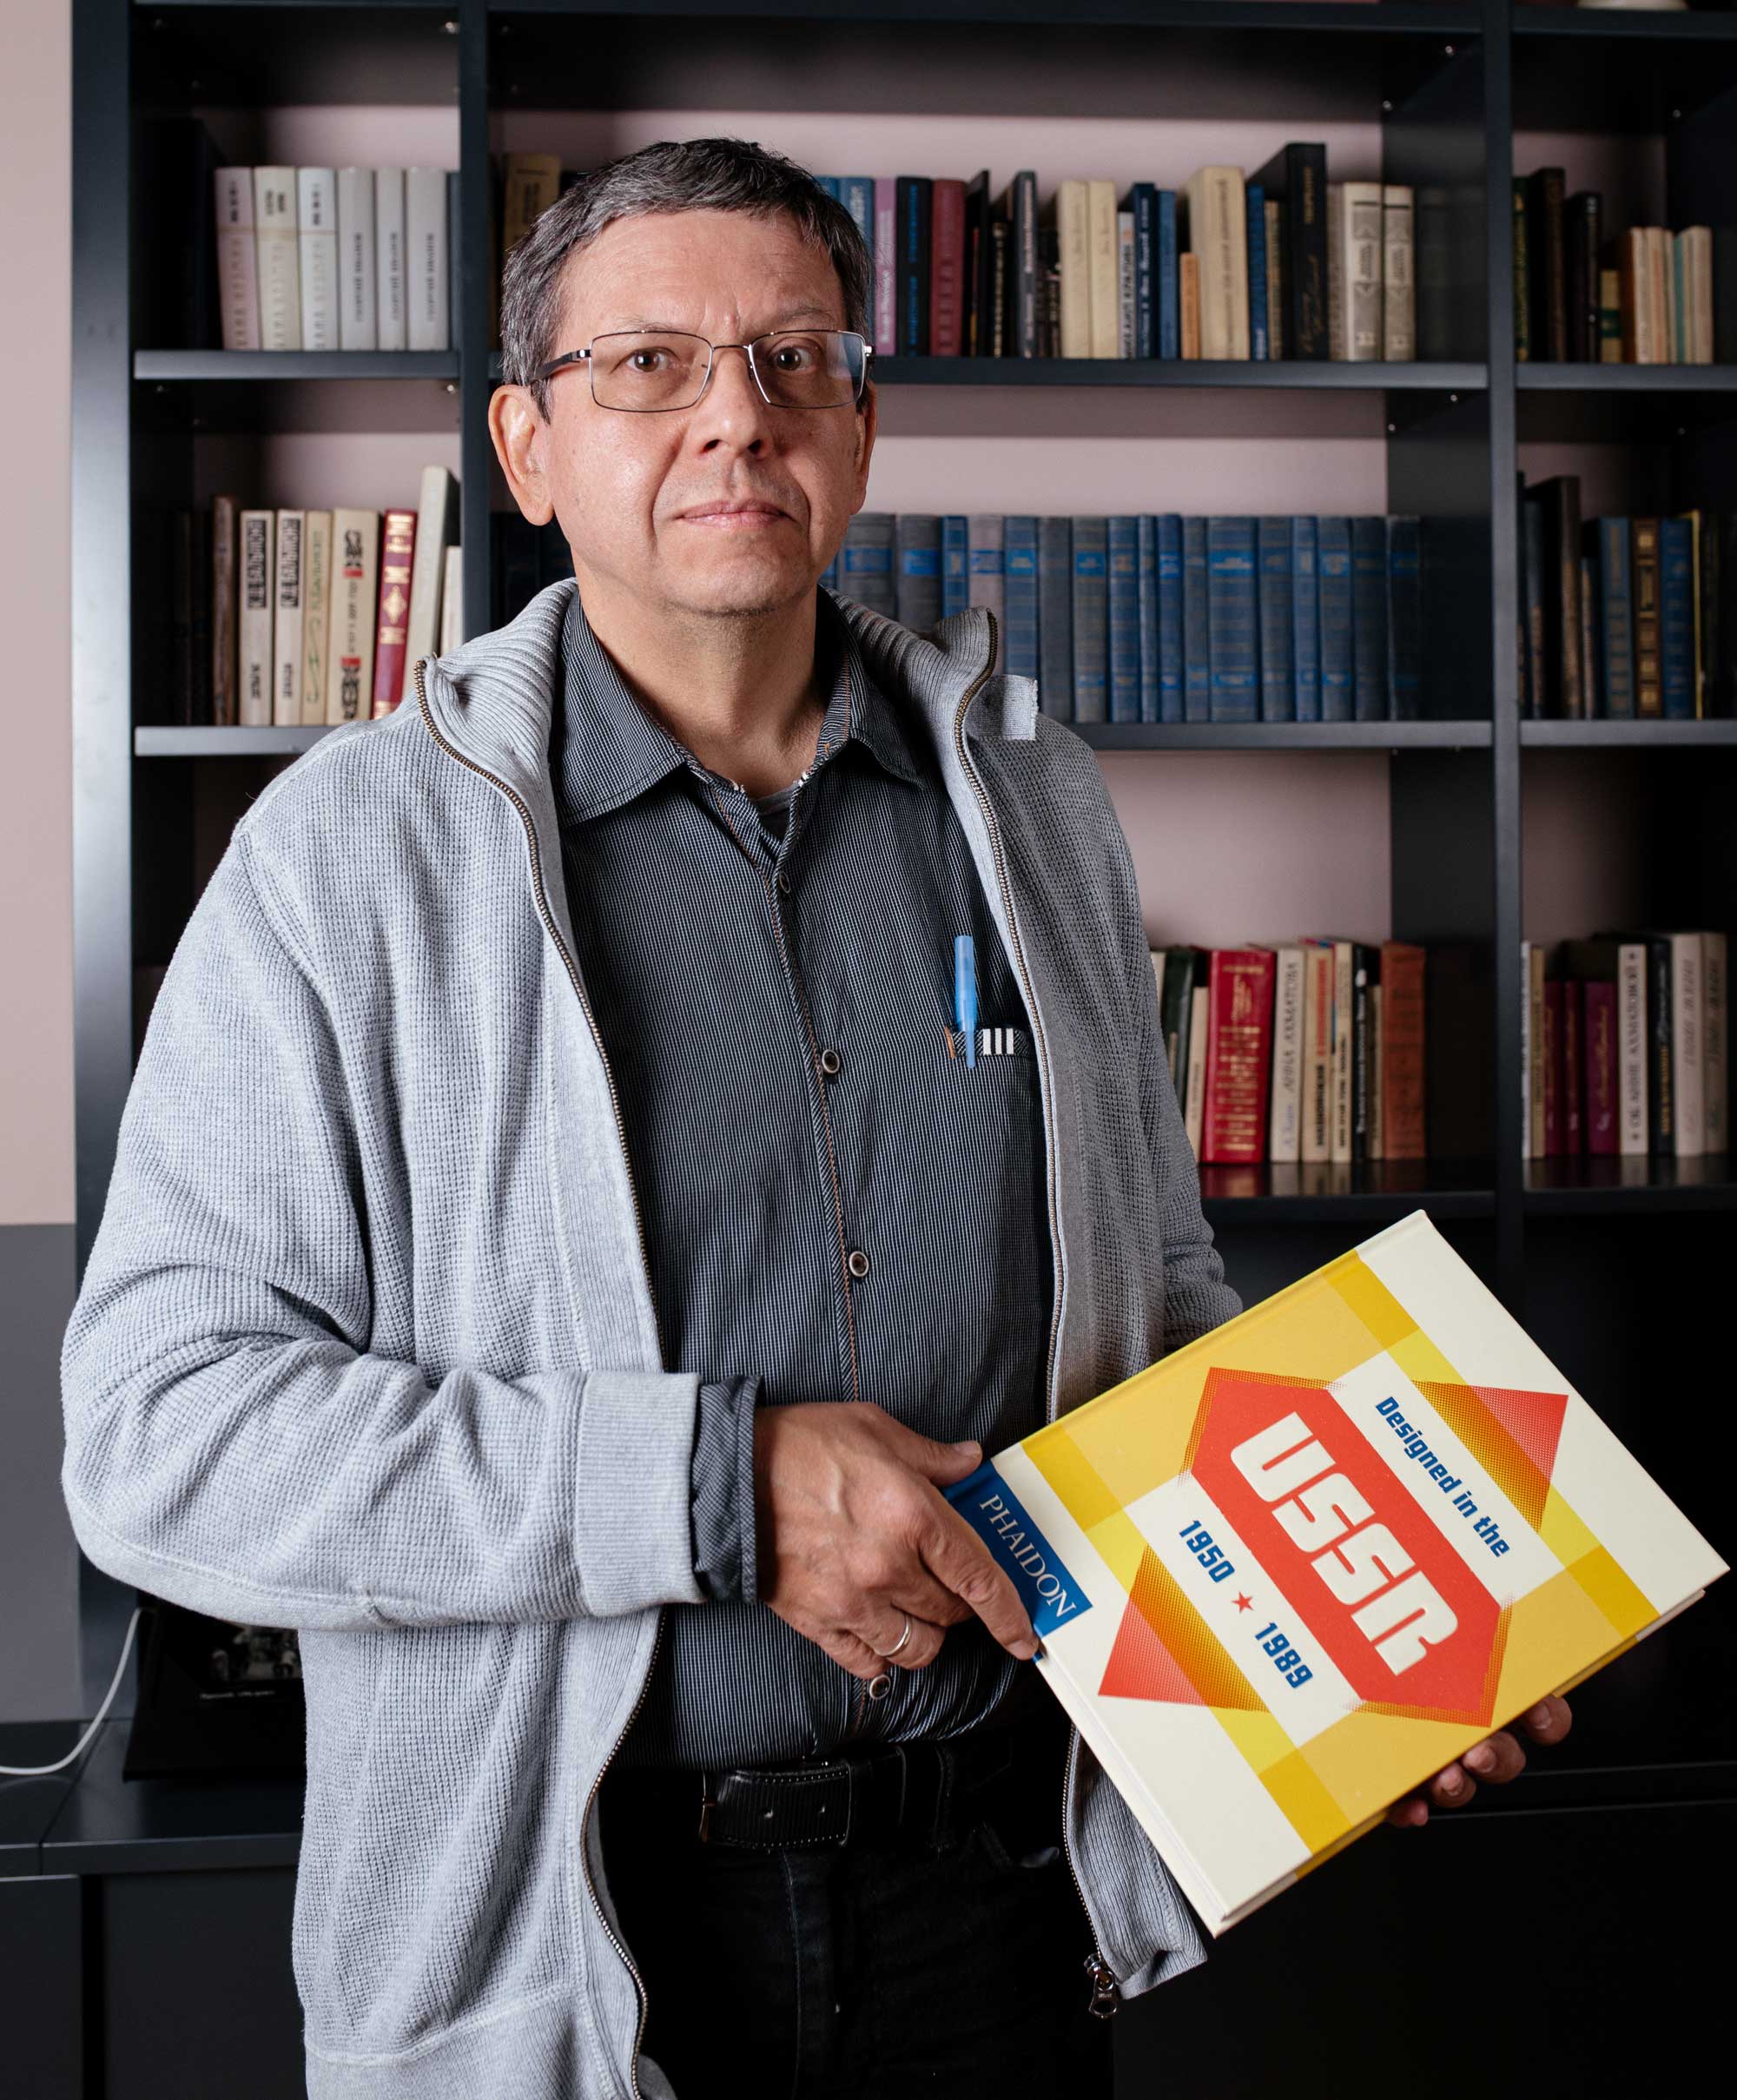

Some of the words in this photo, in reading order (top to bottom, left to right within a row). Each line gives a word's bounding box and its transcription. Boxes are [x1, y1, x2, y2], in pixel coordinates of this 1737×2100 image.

[980, 1494, 1076, 1617] PHAIDON
[1231, 1412, 1458, 1676] USSR
[1376, 1397, 1462, 1493] Designed
[1453, 1493, 1478, 1518] in
[1474, 1516, 1509, 1557] the
[1181, 1521, 1235, 1583] 1950
[1255, 1622, 1313, 1688] 1989
